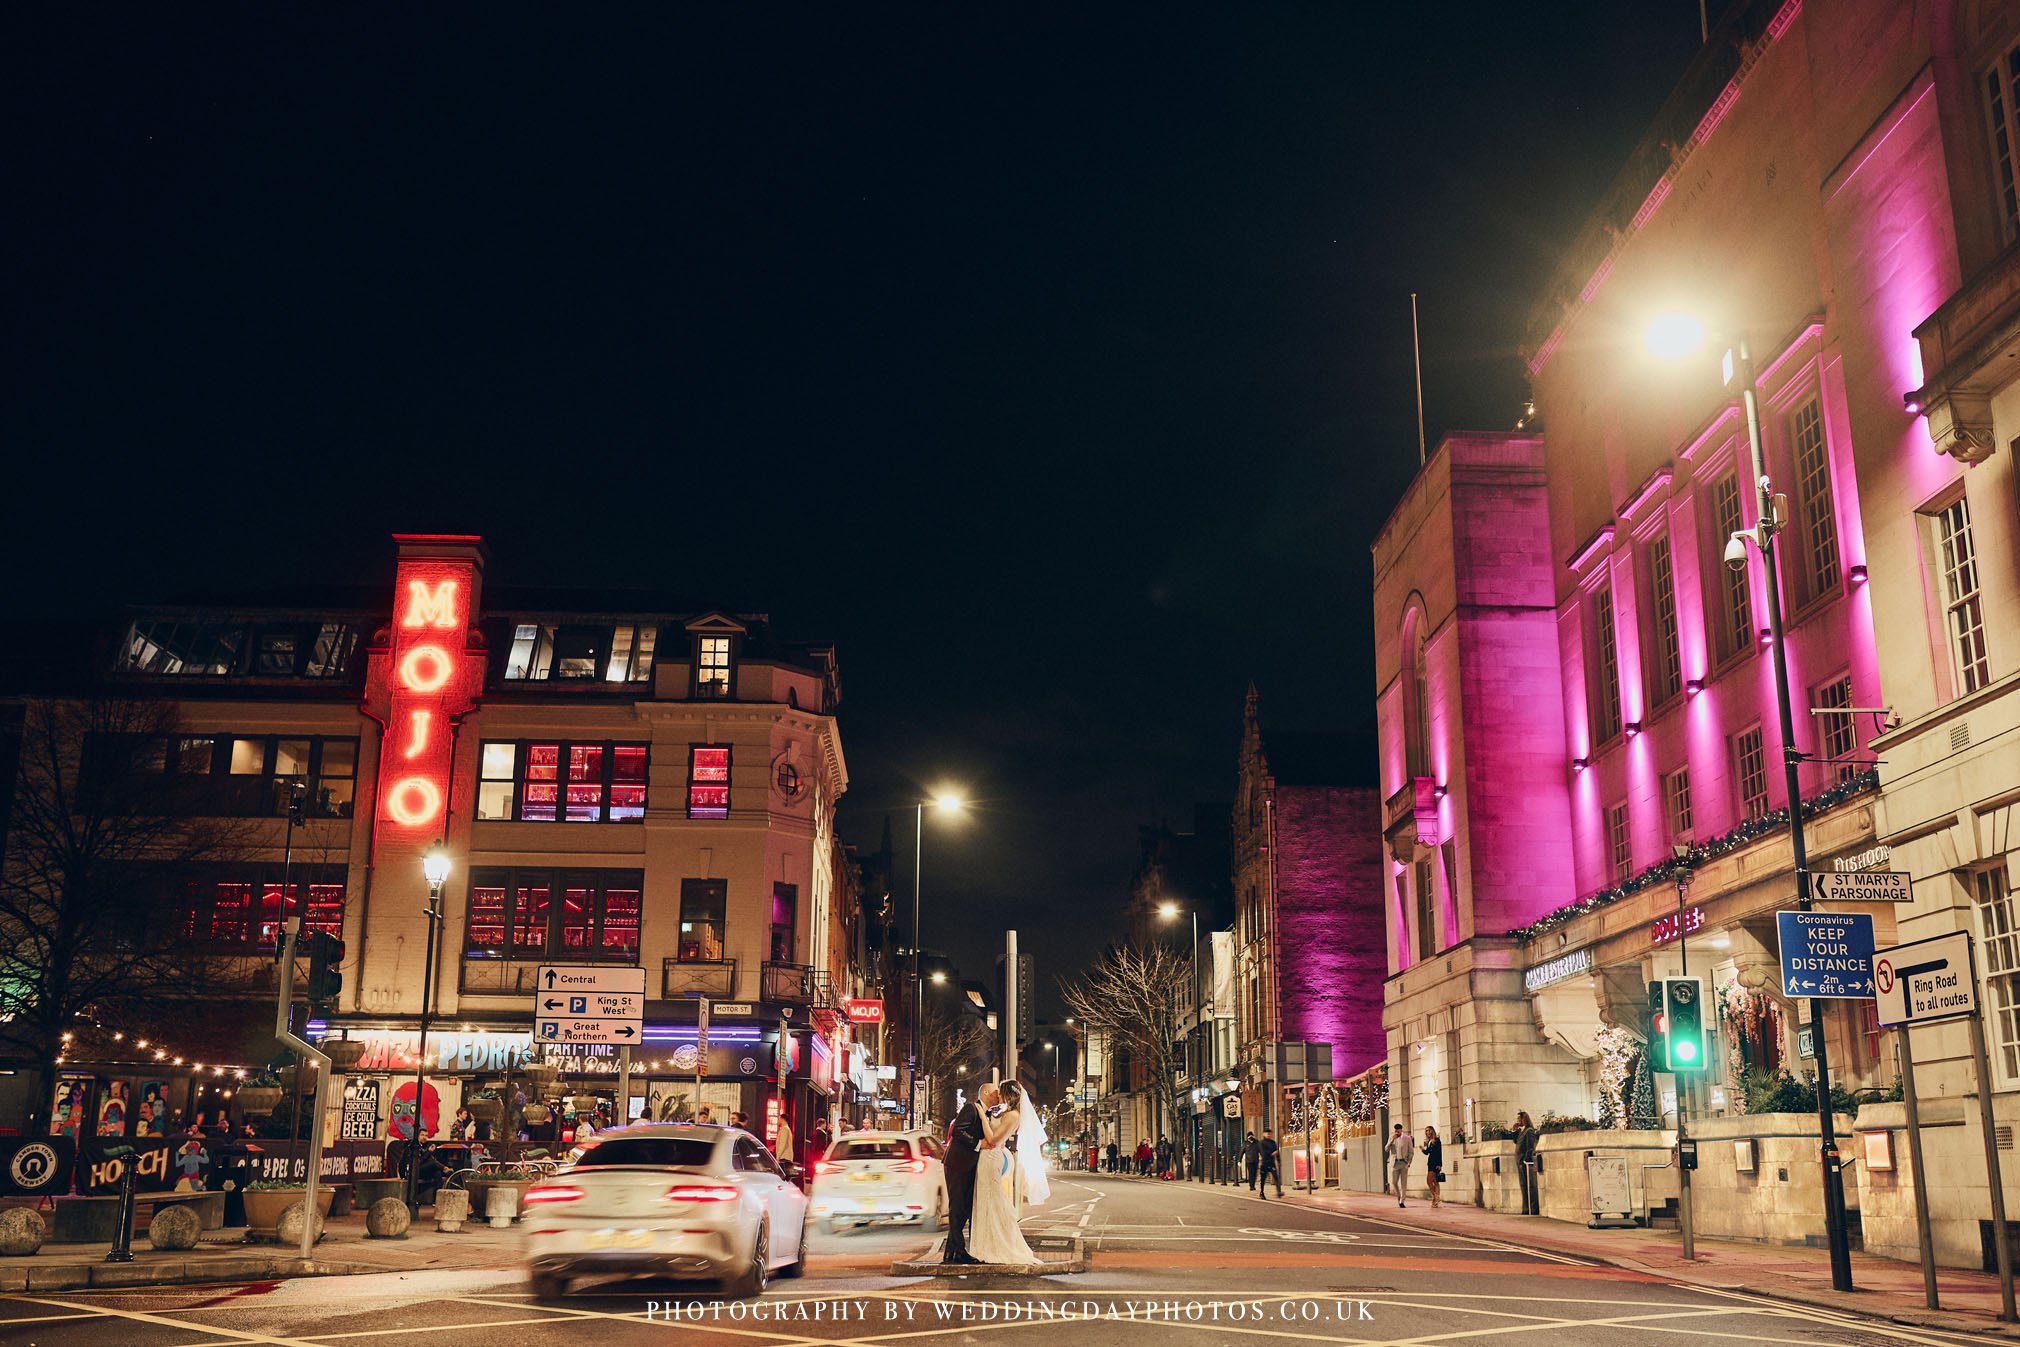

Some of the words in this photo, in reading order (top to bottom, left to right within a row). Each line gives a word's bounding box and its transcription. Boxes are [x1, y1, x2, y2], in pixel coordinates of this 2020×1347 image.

[389, 579, 458, 827] MOJO
[1835, 874, 1850, 885] ST
[1855, 874, 1900, 886] MARY'S
[1831, 888, 1908, 899] PARSONAGE
[1652, 907, 1700, 942] BOUEE
[1797, 915, 1854, 925] Coronavirus
[1808, 928, 1846, 940] KEEP
[1807, 943, 1848, 956] YOUR
[1792, 958, 1868, 972] DISTANCE
[561, 975, 596, 984] Central
[1824, 975, 1839, 985] 2m
[1914, 979, 1934, 993] Ring
[1936, 972, 1958, 987] Road
[1819, 984, 1835, 994] 6ft
[1838, 984, 1845, 994] 6
[598, 997, 618, 1006] King
[621, 997, 632, 1005] St
[1916, 1000, 1925, 1012] to
[1927, 996, 1938, 1010] all
[1940, 993, 1969, 1009] routes
[851, 1006, 880, 1018] MOJO
[574, 1023, 600, 1031] Great
[565, 1033, 607, 1041] Northern
[546, 1043, 614, 1056] PART-TIME
[545, 1056, 581, 1072] PIZZA
[584, 1056, 647, 1073] Parlur
[345, 1087, 377, 1100] PIZZA
[345, 1102, 376, 1111] COCKTAILS
[344, 1112, 356, 1121] ICE
[357, 1112, 375, 1122] COLD
[342, 1122, 374, 1138] BEER
[16, 1146, 39, 1163] CAMDEN
[41, 1147, 53, 1162] TOWN
[90, 1147, 169, 1187] HOCH
